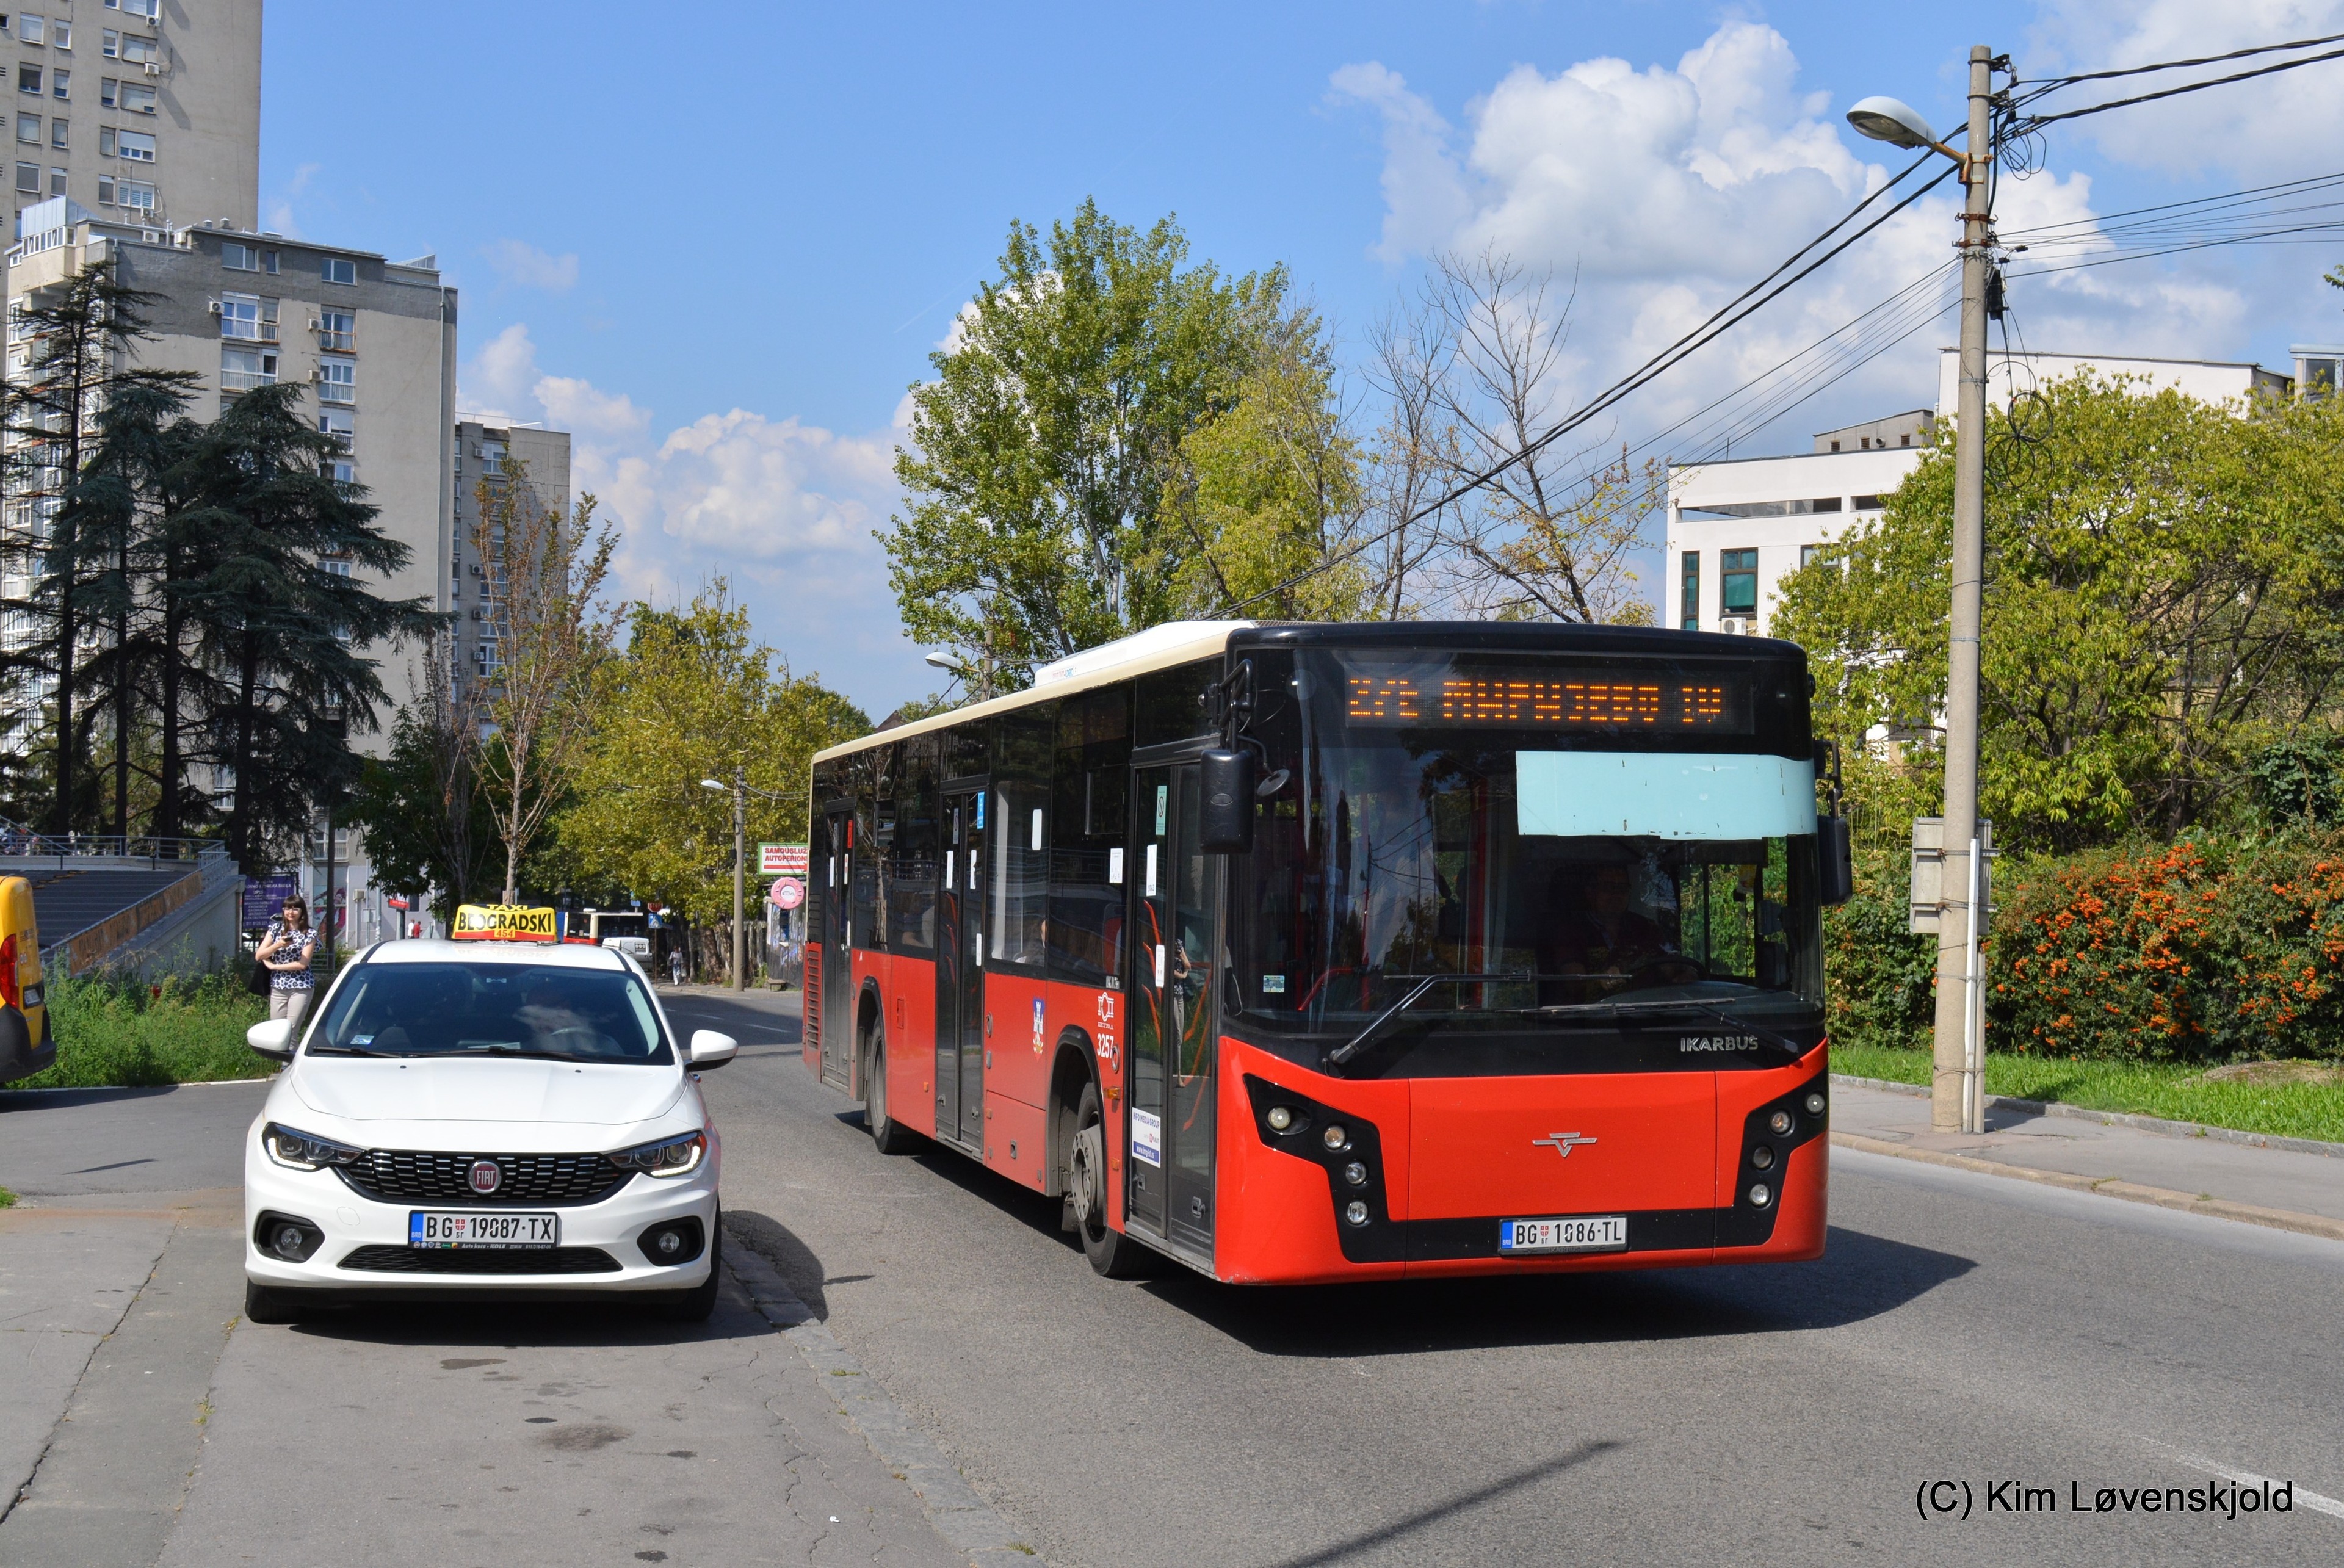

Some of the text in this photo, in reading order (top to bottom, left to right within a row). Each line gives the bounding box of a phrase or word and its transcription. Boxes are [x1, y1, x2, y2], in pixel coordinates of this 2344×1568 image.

[458, 912, 551, 933] BEOGRADSKI
[496, 930, 513, 938] 454
[1097, 1033, 1114, 1059] 3257
[1680, 1036, 1759, 1052] IKARBUS
[476, 1171, 496, 1185] FIAT
[427, 1217, 453, 1238] BG
[1516, 1224, 1538, 1245] BG
